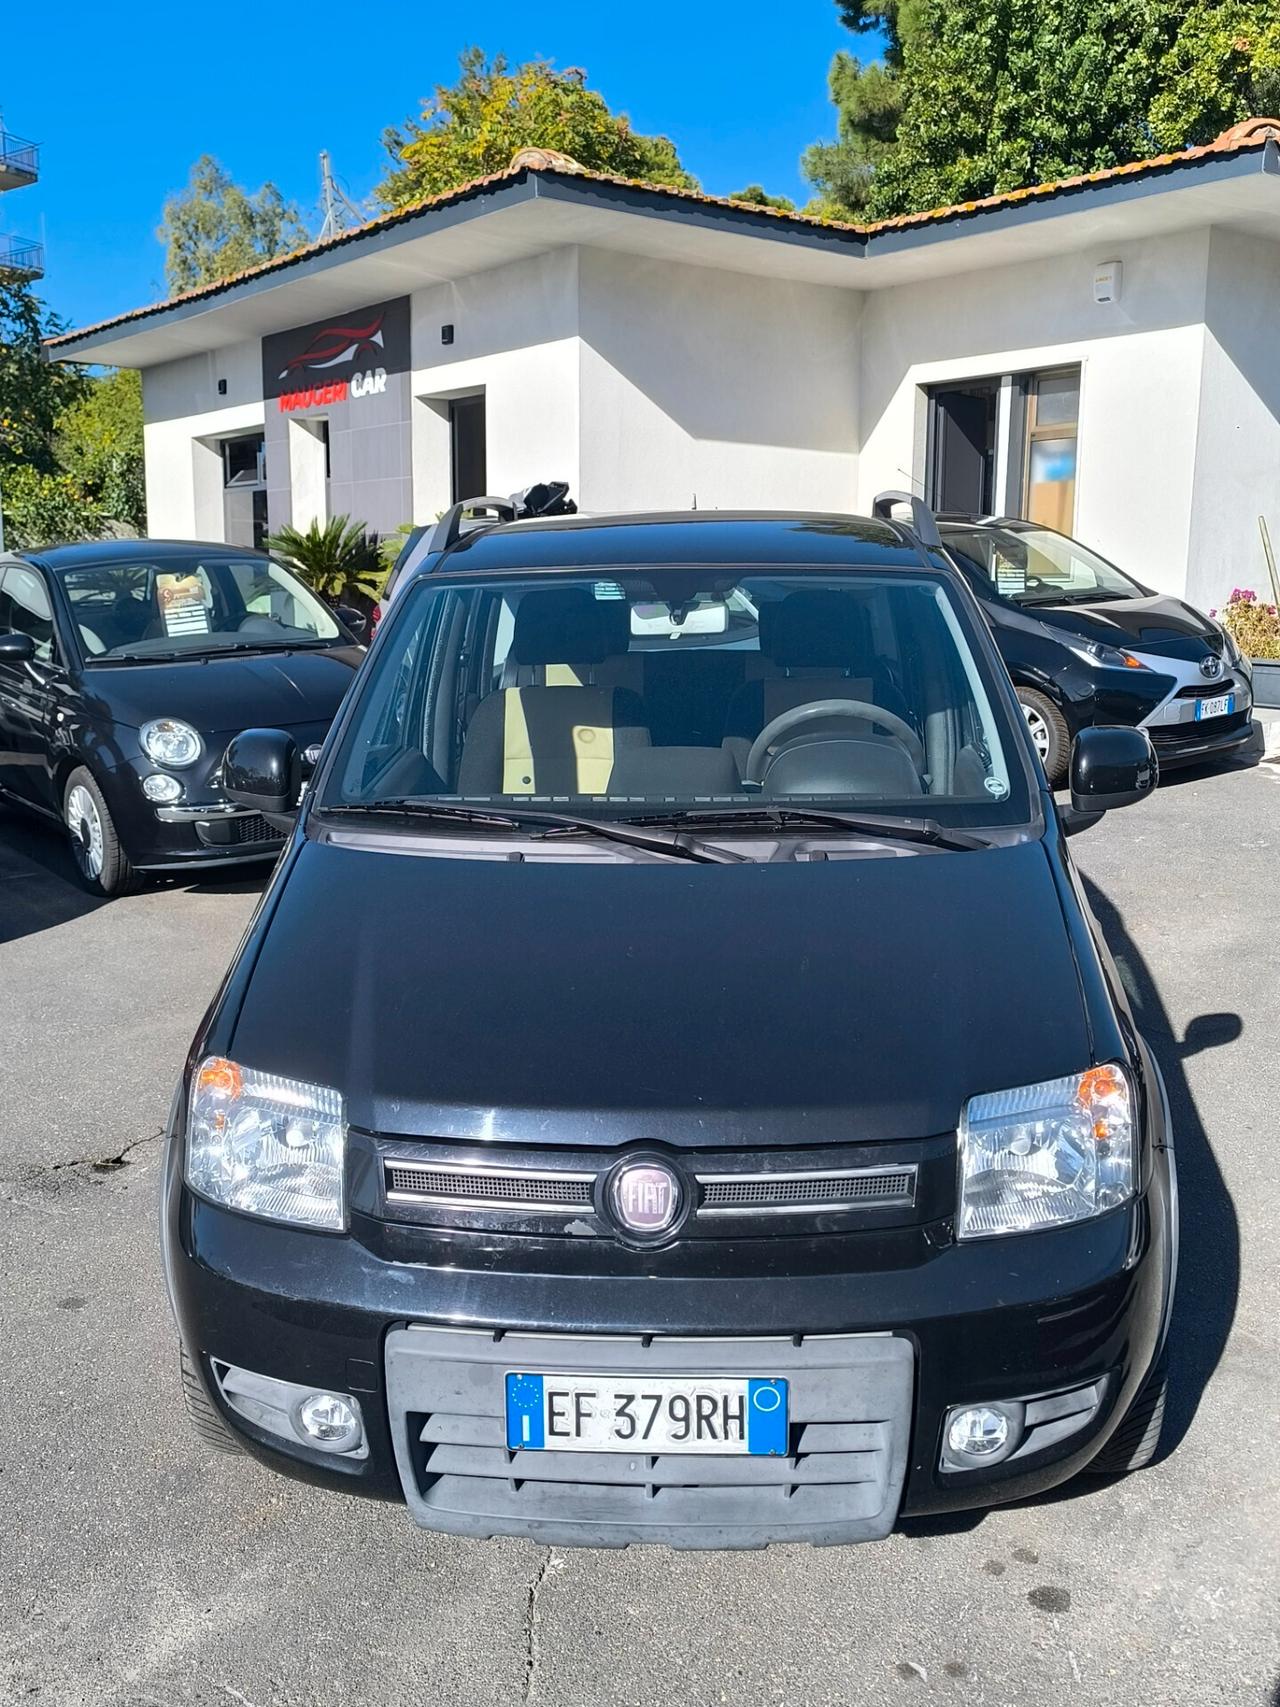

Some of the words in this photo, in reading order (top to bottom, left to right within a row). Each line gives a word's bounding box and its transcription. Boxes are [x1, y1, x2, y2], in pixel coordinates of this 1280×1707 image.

[278, 379, 348, 412] MAUGERI
[350, 367, 388, 399] CAR
[627, 1182, 668, 1214] FIAT
[547, 1391, 597, 1438] EF
[613, 1393, 746, 1441] 379RH
